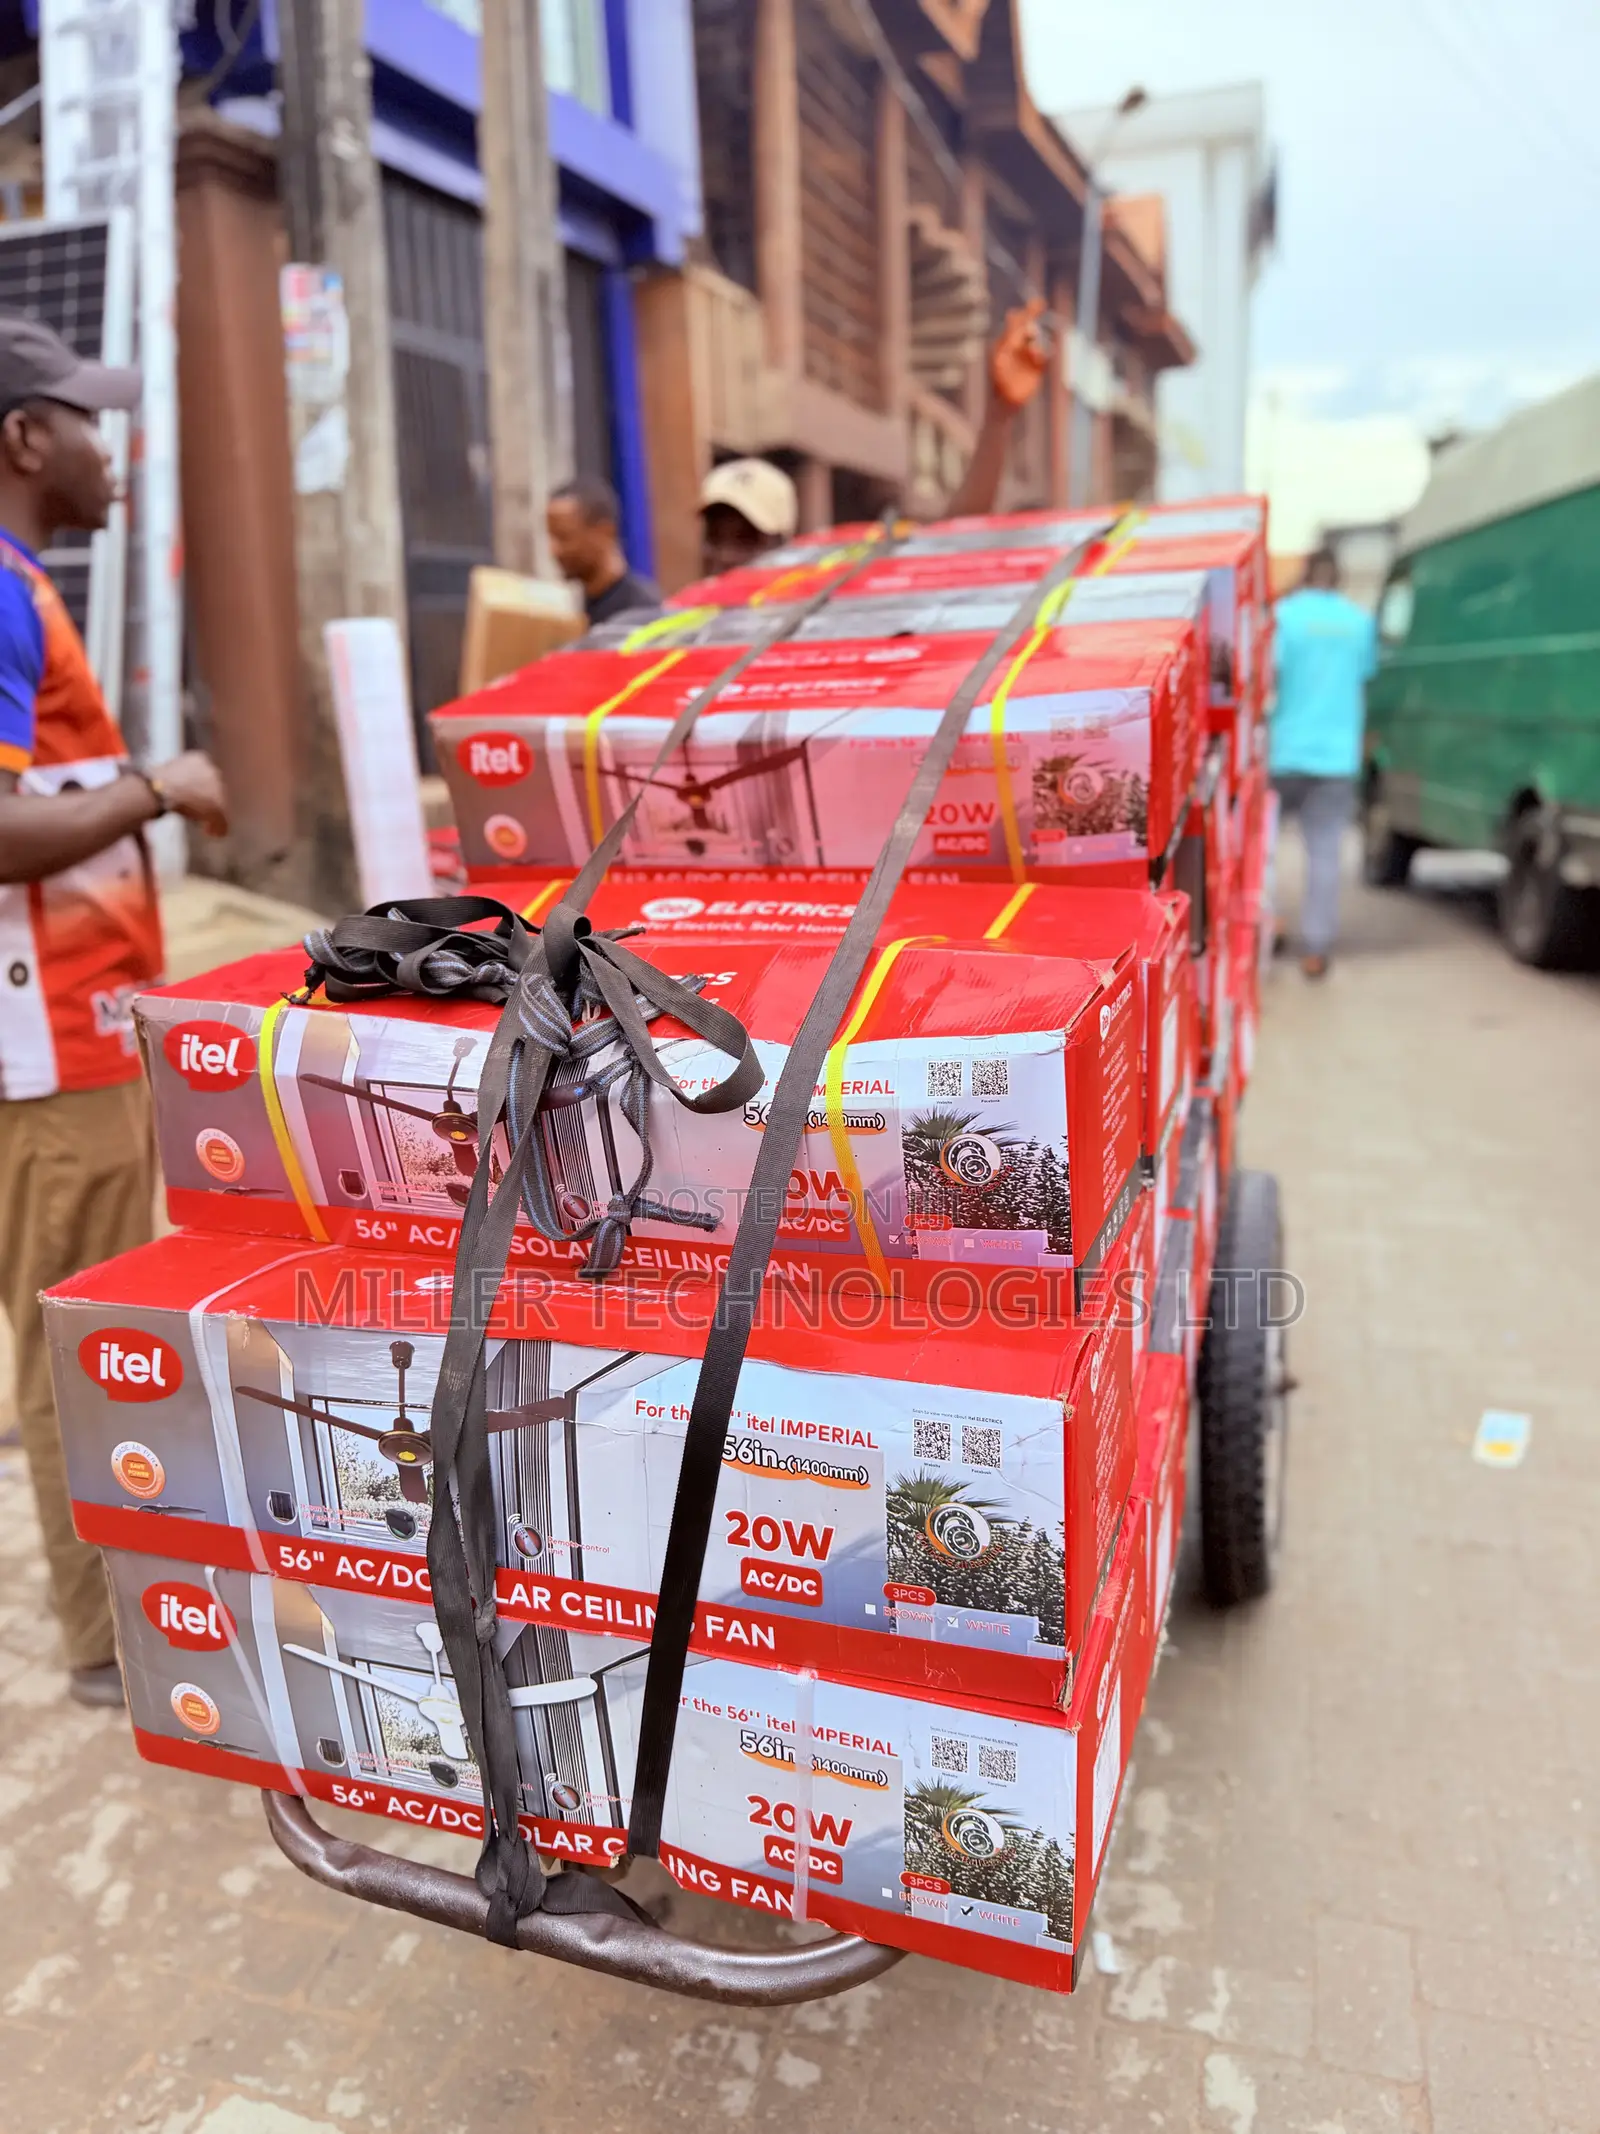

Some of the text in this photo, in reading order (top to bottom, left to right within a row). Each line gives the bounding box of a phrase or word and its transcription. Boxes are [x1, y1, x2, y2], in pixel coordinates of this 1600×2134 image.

[470, 741, 523, 774] itel
[706, 901, 858, 918] ELECTRICS
[180, 1034, 240, 1077] itel
[701, 1076, 721, 1091] th
[784, 1169, 849, 1202] 0W
[778, 1218, 844, 1233] AC/DC
[979, 1238, 1023, 1250] WHITE
[356, 1219, 812, 1283] 56" AC/ SOLA CEILING AN
[100, 1341, 166, 1387] itel
[635, 1399, 665, 1419] For
[670, 1403, 691, 1422] th
[746, 1413, 775, 1434] itel
[781, 1418, 879, 1449] IMPERIAL
[724, 1509, 835, 1562] 20W
[280, 1546, 325, 1571] 56"
[494, 1579, 552, 1612] LAR
[705, 1614, 776, 1650] FAN
[745, 1569, 818, 1596] AC/DC
[892, 1587, 927, 1602] 3PCS
[160, 1594, 222, 1640] itel
[882, 1606, 1011, 1635] BROWN WHITE
[693, 1697, 722, 1716] the
[766, 1714, 796, 1734] itel
[746, 1794, 854, 1848] 20W
[331, 1783, 376, 1808] 56"
[386, 1796, 483, 1832] AC/DC
[518, 1823, 594, 1856] OLAR
[731, 1878, 795, 1915] FAN
[909, 1875, 942, 1891] 3PCS
[898, 1891, 1021, 1928] BROWN WHITE
